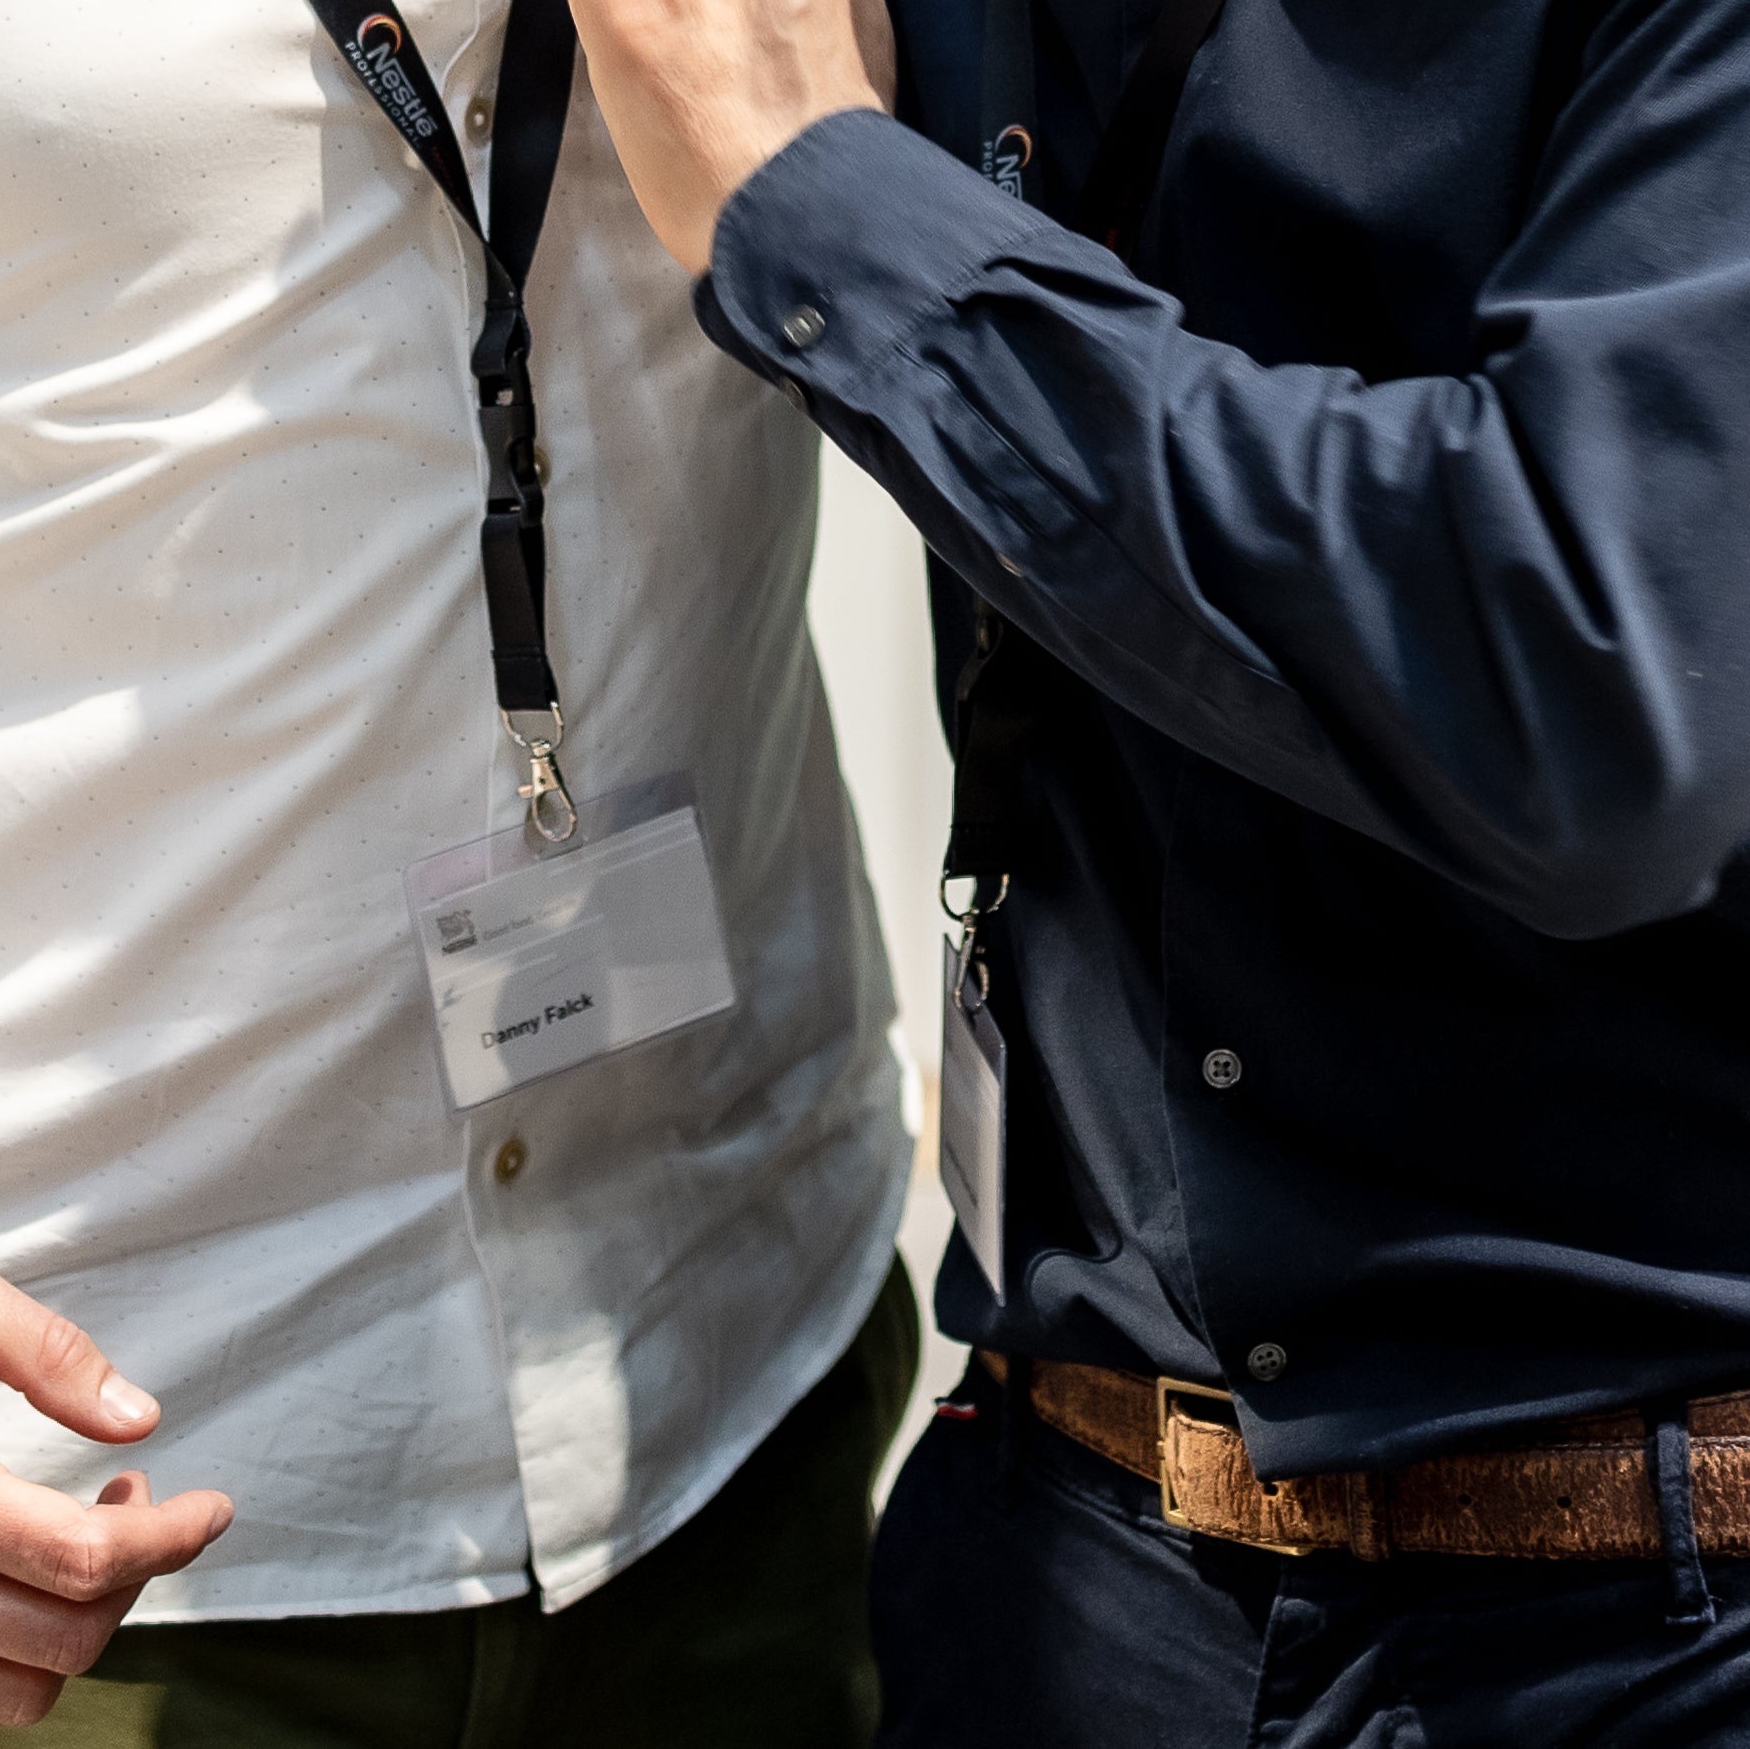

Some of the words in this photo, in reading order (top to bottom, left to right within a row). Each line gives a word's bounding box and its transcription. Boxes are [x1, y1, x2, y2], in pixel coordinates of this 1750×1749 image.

[366, 41, 439, 138] Nestlé
[481, 1016, 541, 1050] Danny
[544, 993, 595, 1024] Falck
